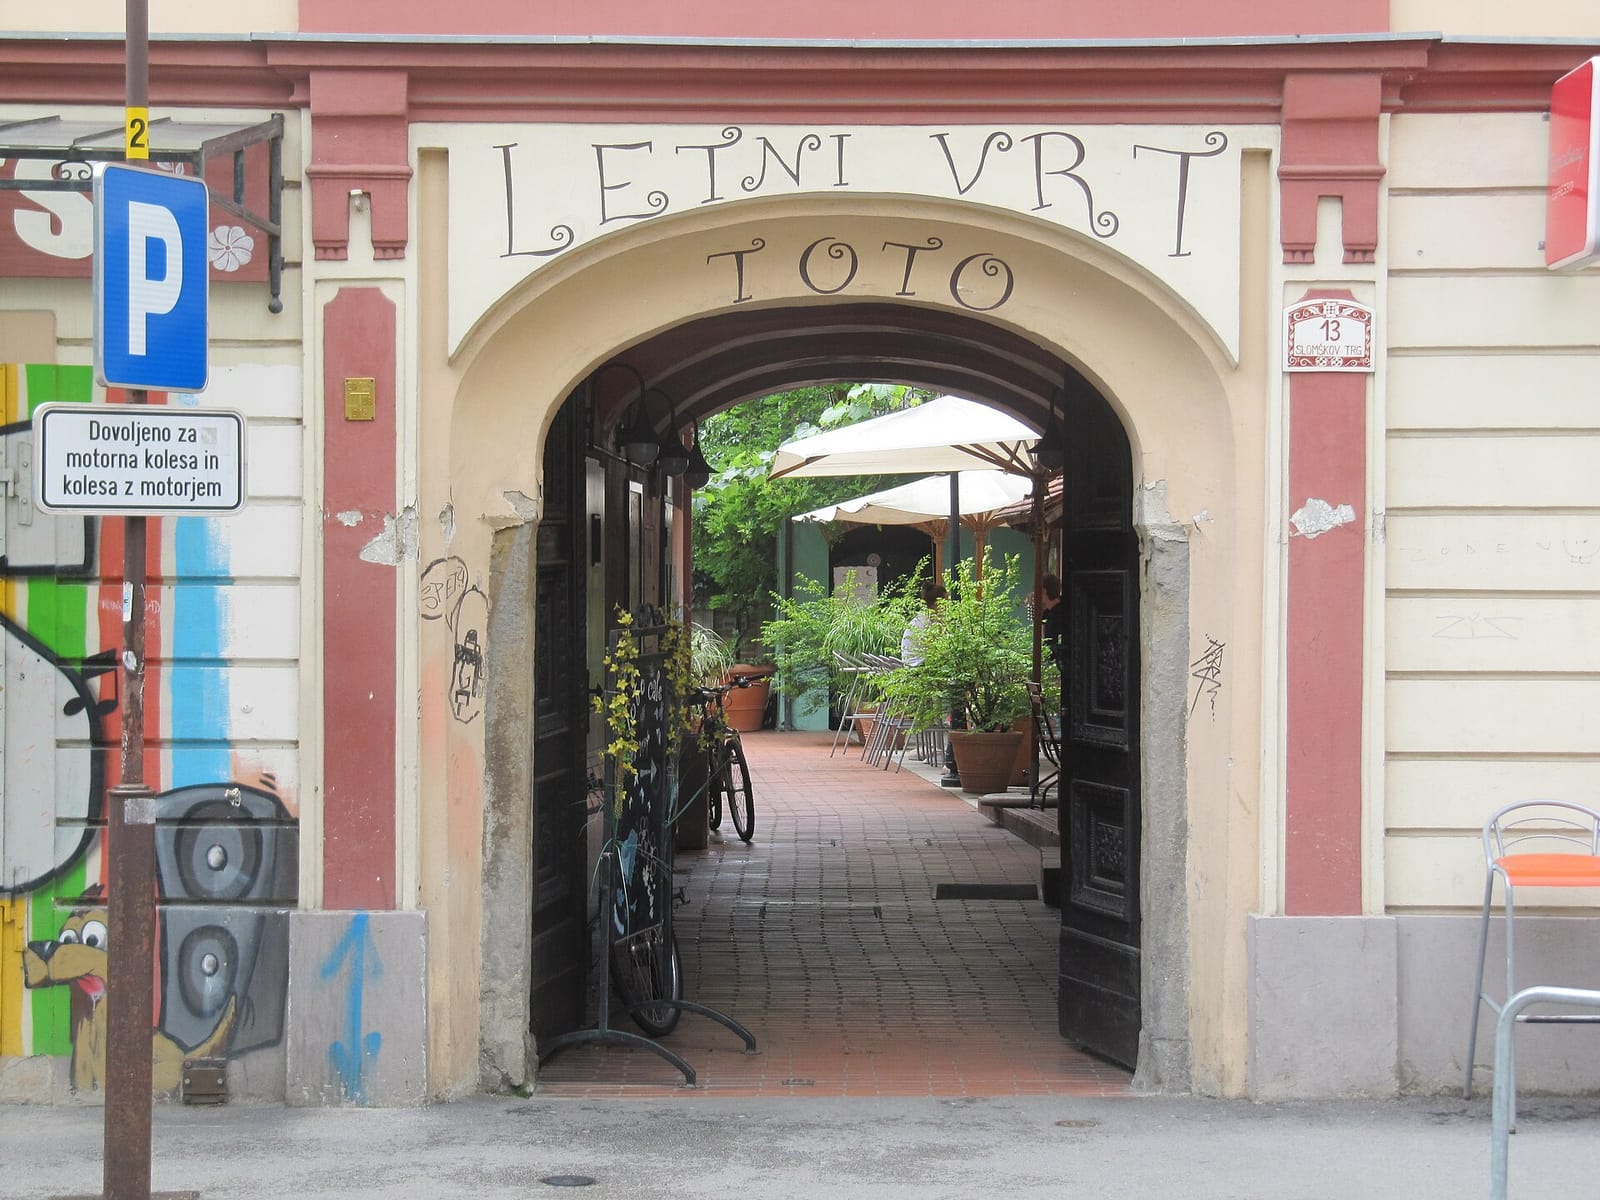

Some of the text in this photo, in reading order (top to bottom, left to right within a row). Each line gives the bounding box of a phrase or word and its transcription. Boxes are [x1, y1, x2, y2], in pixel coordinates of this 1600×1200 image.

[130, 118, 146, 148] 2
[492, 126, 1228, 258] LETNI VRT
[0, 157, 94, 260] S
[128, 200, 183, 356] P
[706, 237, 1014, 312] TOTO
[1320, 319, 1341, 341] 13
[1296, 344, 1362, 355] SLOMŠKOV TRG
[89, 420, 197, 447] Dovoljeno za
[66, 449, 219, 470] motorna kolesa in
[63, 474, 222, 502] kolesa z motorjem
